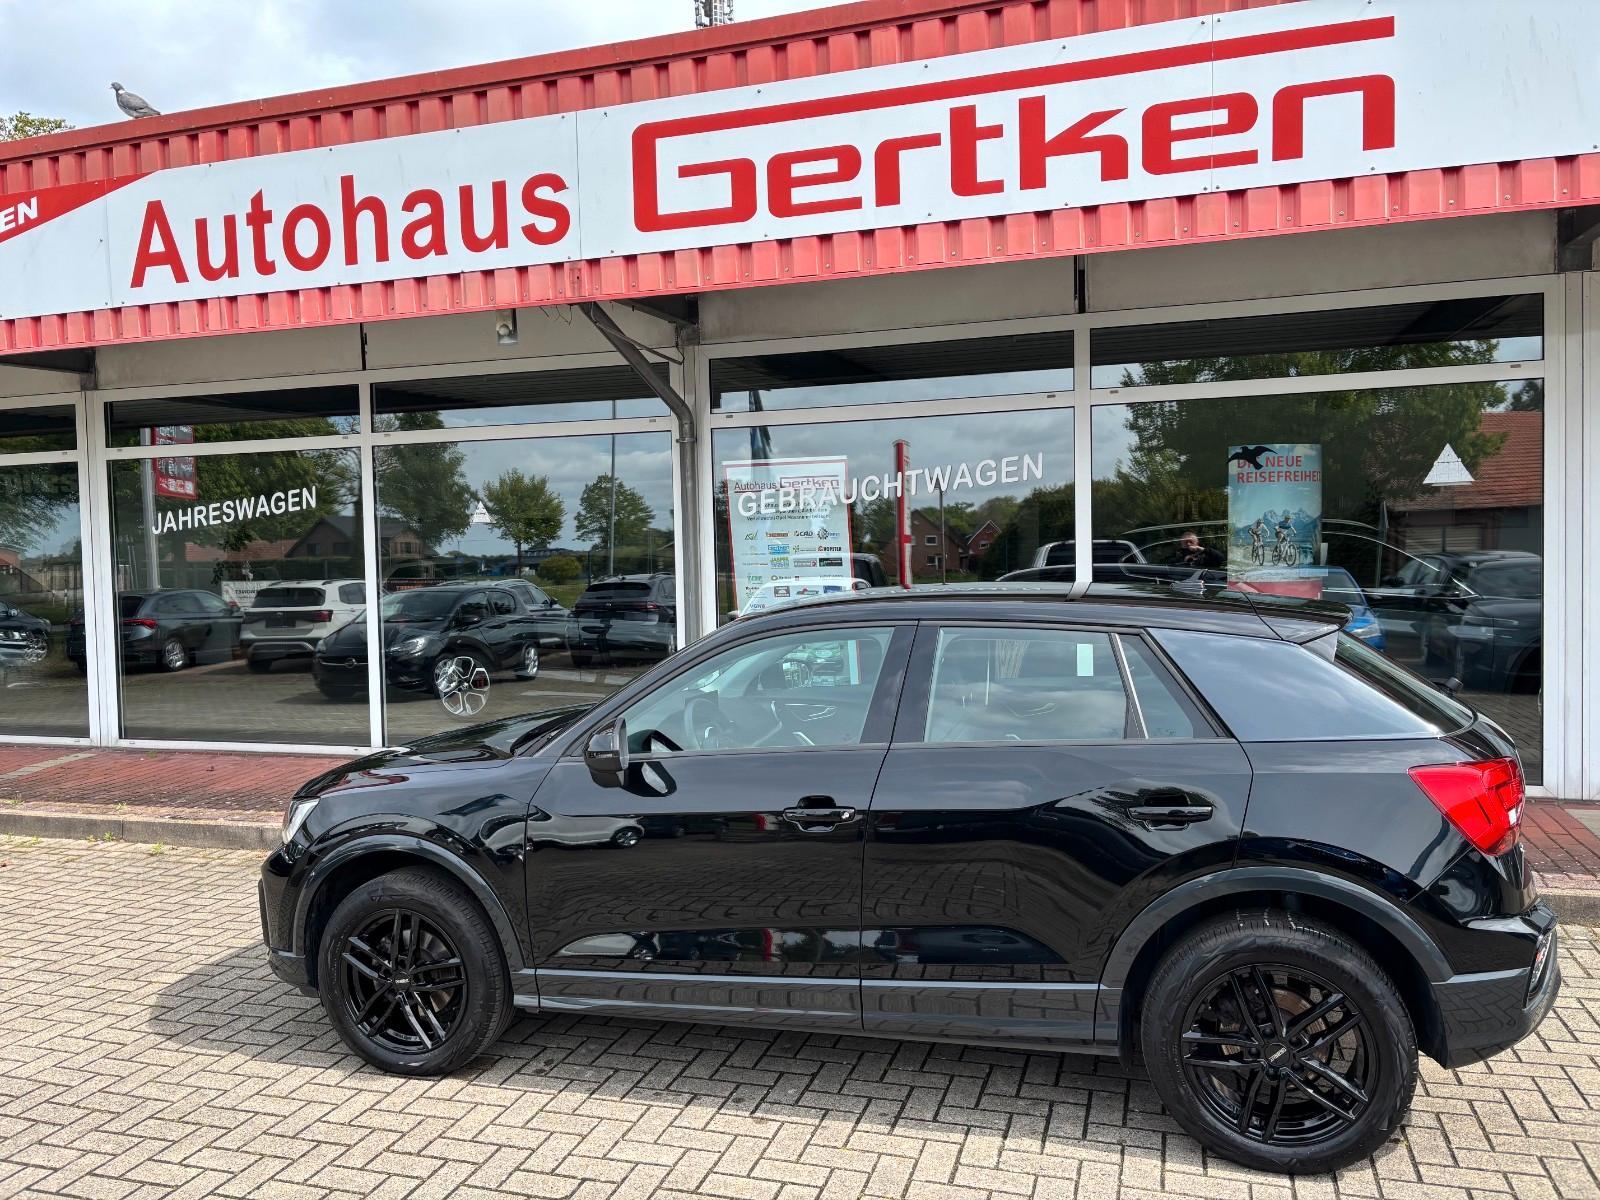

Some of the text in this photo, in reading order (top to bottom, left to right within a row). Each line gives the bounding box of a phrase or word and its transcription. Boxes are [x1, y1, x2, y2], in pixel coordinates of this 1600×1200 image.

[130, 16, 1395, 288] Autohaus Gertken
[734, 481, 777, 491] Autohaus
[737, 452, 1043, 517] GEBRAUCHTWAGEN
[1265, 456, 1302, 468] NEUE
[152, 485, 317, 535] JAHRESWAGEN
